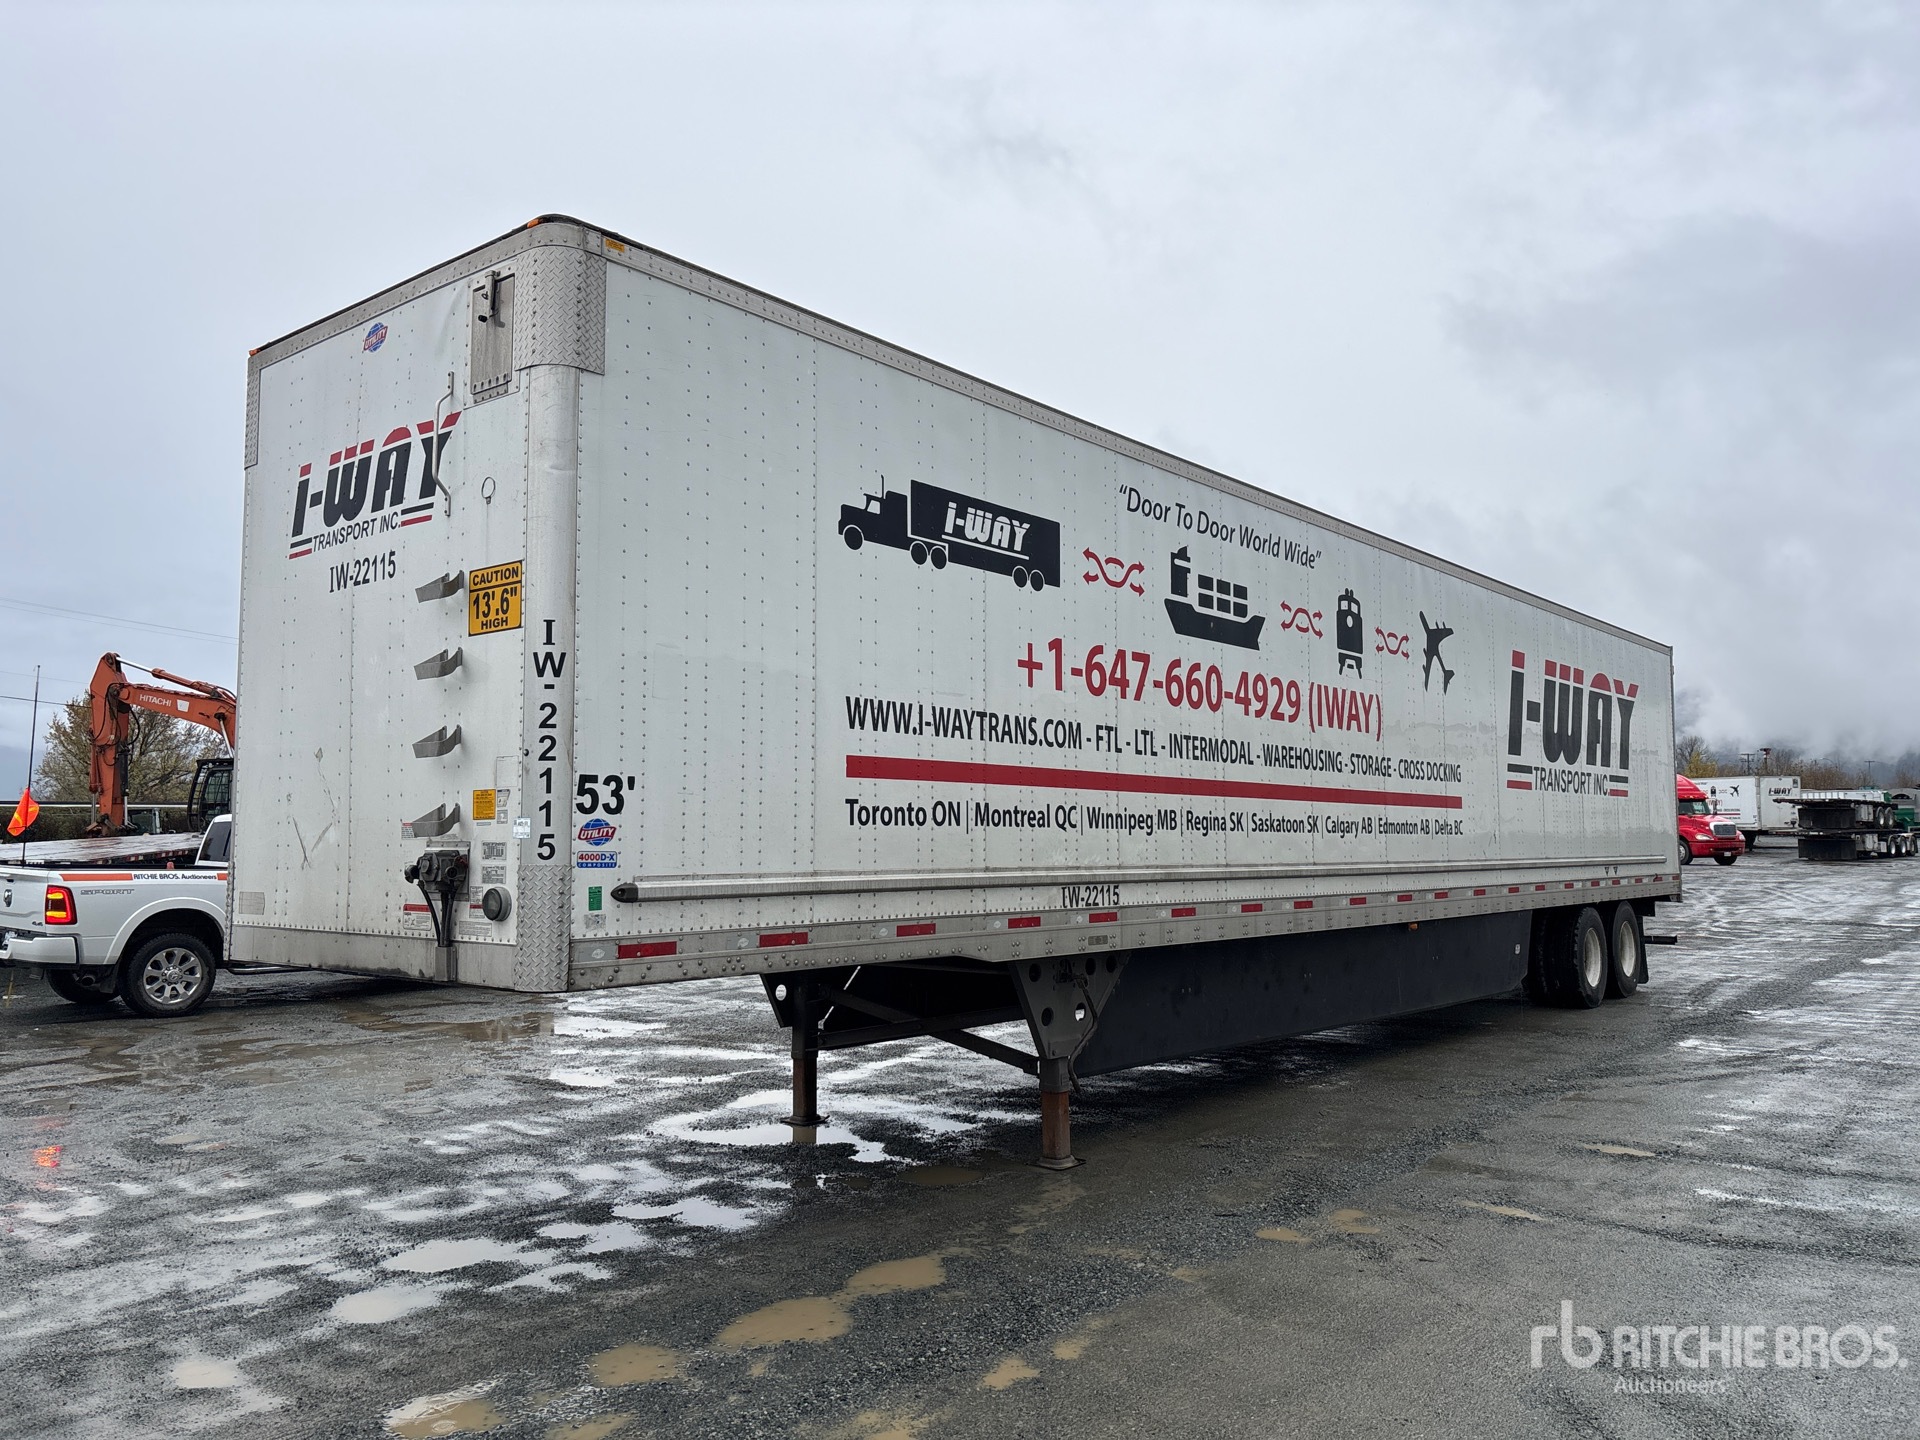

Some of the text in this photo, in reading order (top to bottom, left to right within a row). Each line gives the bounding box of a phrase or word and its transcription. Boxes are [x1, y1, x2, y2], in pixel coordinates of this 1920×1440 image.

[313, 511, 400, 552] TRANSPORT INC.
[1175, 502, 1193, 530] To
[1197, 511, 1235, 543] Door
[1239, 524, 1281, 558] World
[329, 550, 396, 593] IW-22115
[472, 565, 519, 586] CAUTION
[481, 616, 509, 630] HIGH
[139, 694, 172, 707] HITACHI
[1017, 638, 1382, 741] +1-647-660-4929 (IWAY)
[845, 695, 1083, 750] WWW.I-WAYTRANS.COM
[1096, 724, 1123, 753] FTL
[1134, 728, 1158, 757] LTL
[1169, 732, 1254, 765] INTERMODAL
[1262, 743, 1343, 773] WAREHOUSING
[1350, 753, 1392, 777] STORAGE
[1398, 758, 1425, 780] CROSS
[1426, 761, 1462, 783] DOCKING
[575, 774, 636, 815] 53'
[1533, 766, 1611, 796] TRANSPORT INC.
[579, 826, 616, 840] UTILITY
[845, 798, 928, 826] Toronto
[931, 801, 961, 826] ON
[974, 802, 1051, 828] Montreal
[1054, 805, 1078, 832] QC
[1086, 806, 1154, 836] Winnipeg
[1157, 809, 1178, 831] MB
[1186, 810, 1227, 837] Regina
[1229, 811, 1245, 832] SK
[1251, 812, 1305, 833] Saskatoon
[1307, 814, 1320, 834] SK
[1325, 815, 1360, 839] Calgary
[1360, 816, 1373, 834] AB
[1378, 817, 1419, 835] Edmonton
[1419, 818, 1431, 835] AB
[1434, 818, 1453, 835] Delta
[1454, 820, 1464, 835] BC
[578, 853, 616, 862] 4000D-X
